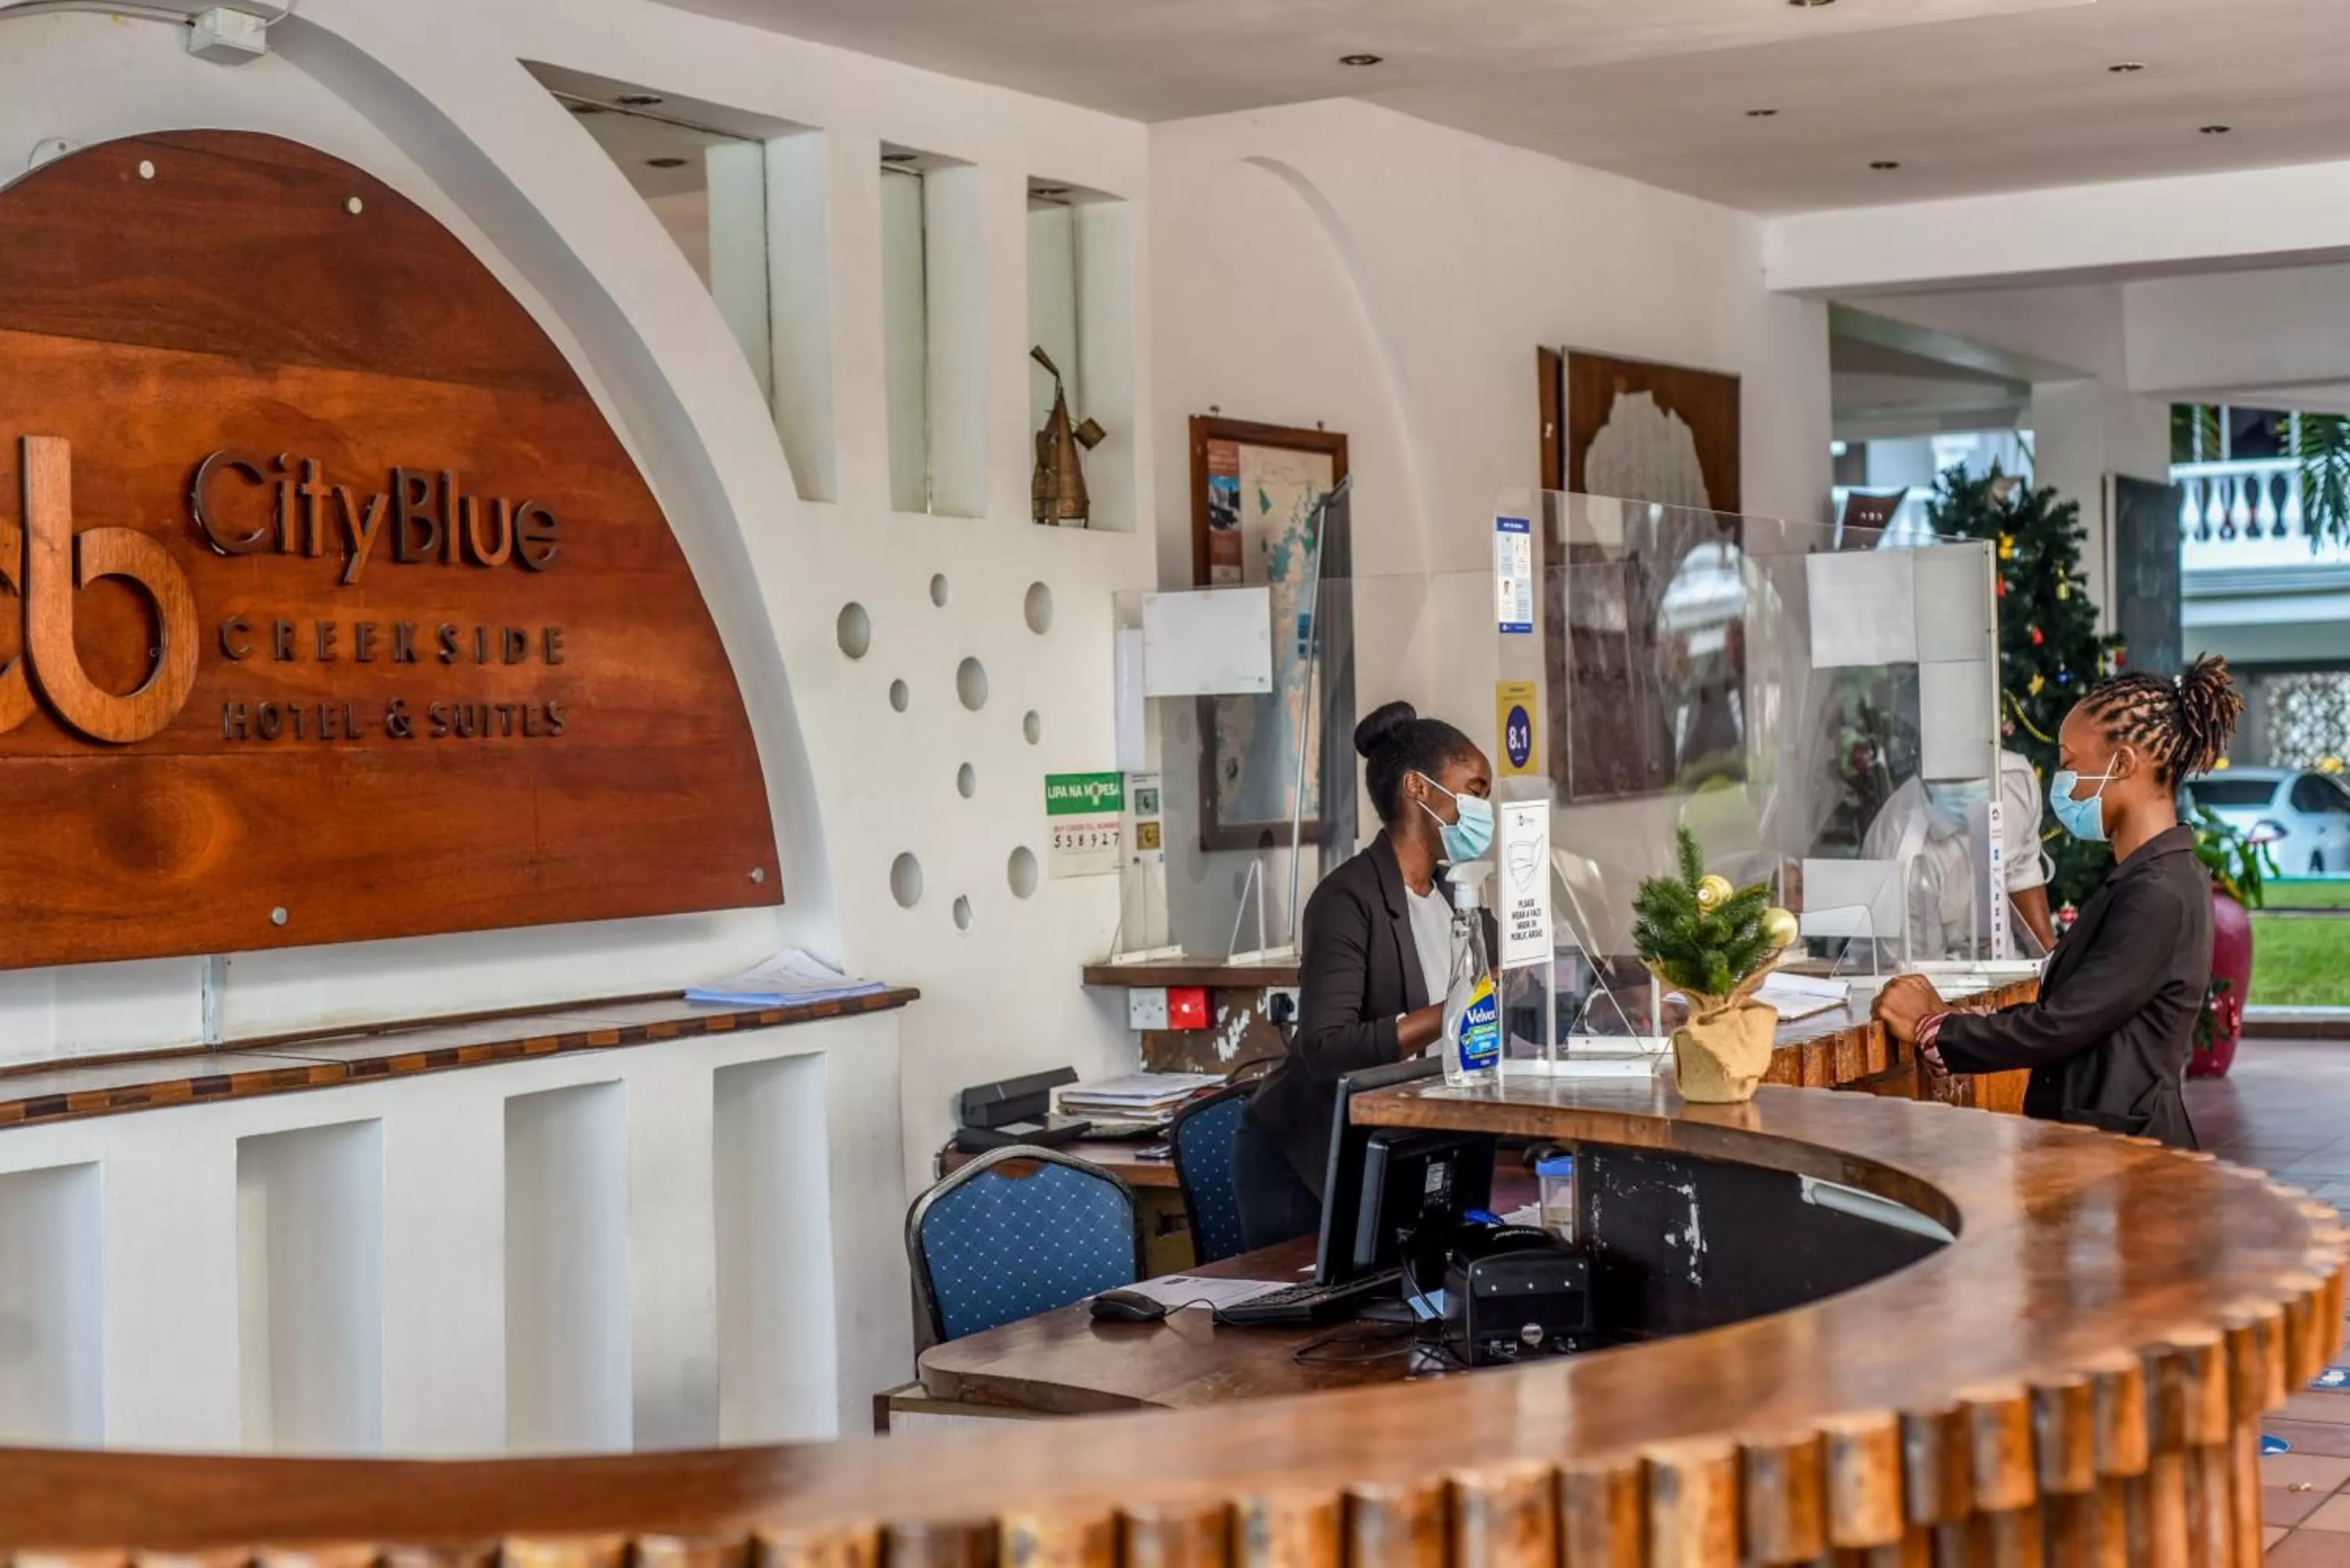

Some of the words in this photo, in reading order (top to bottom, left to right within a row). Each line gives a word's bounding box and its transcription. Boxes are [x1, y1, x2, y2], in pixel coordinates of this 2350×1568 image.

[220, 617, 564, 664] CREEKSIDE
[223, 701, 362, 739] HOTEL
[385, 699, 414, 739] &
[429, 700, 565, 738] SUITES
[1509, 726, 1528, 750] 8.1
[1048, 785, 1067, 799] LIPA
[1068, 783, 1083, 798] NA
